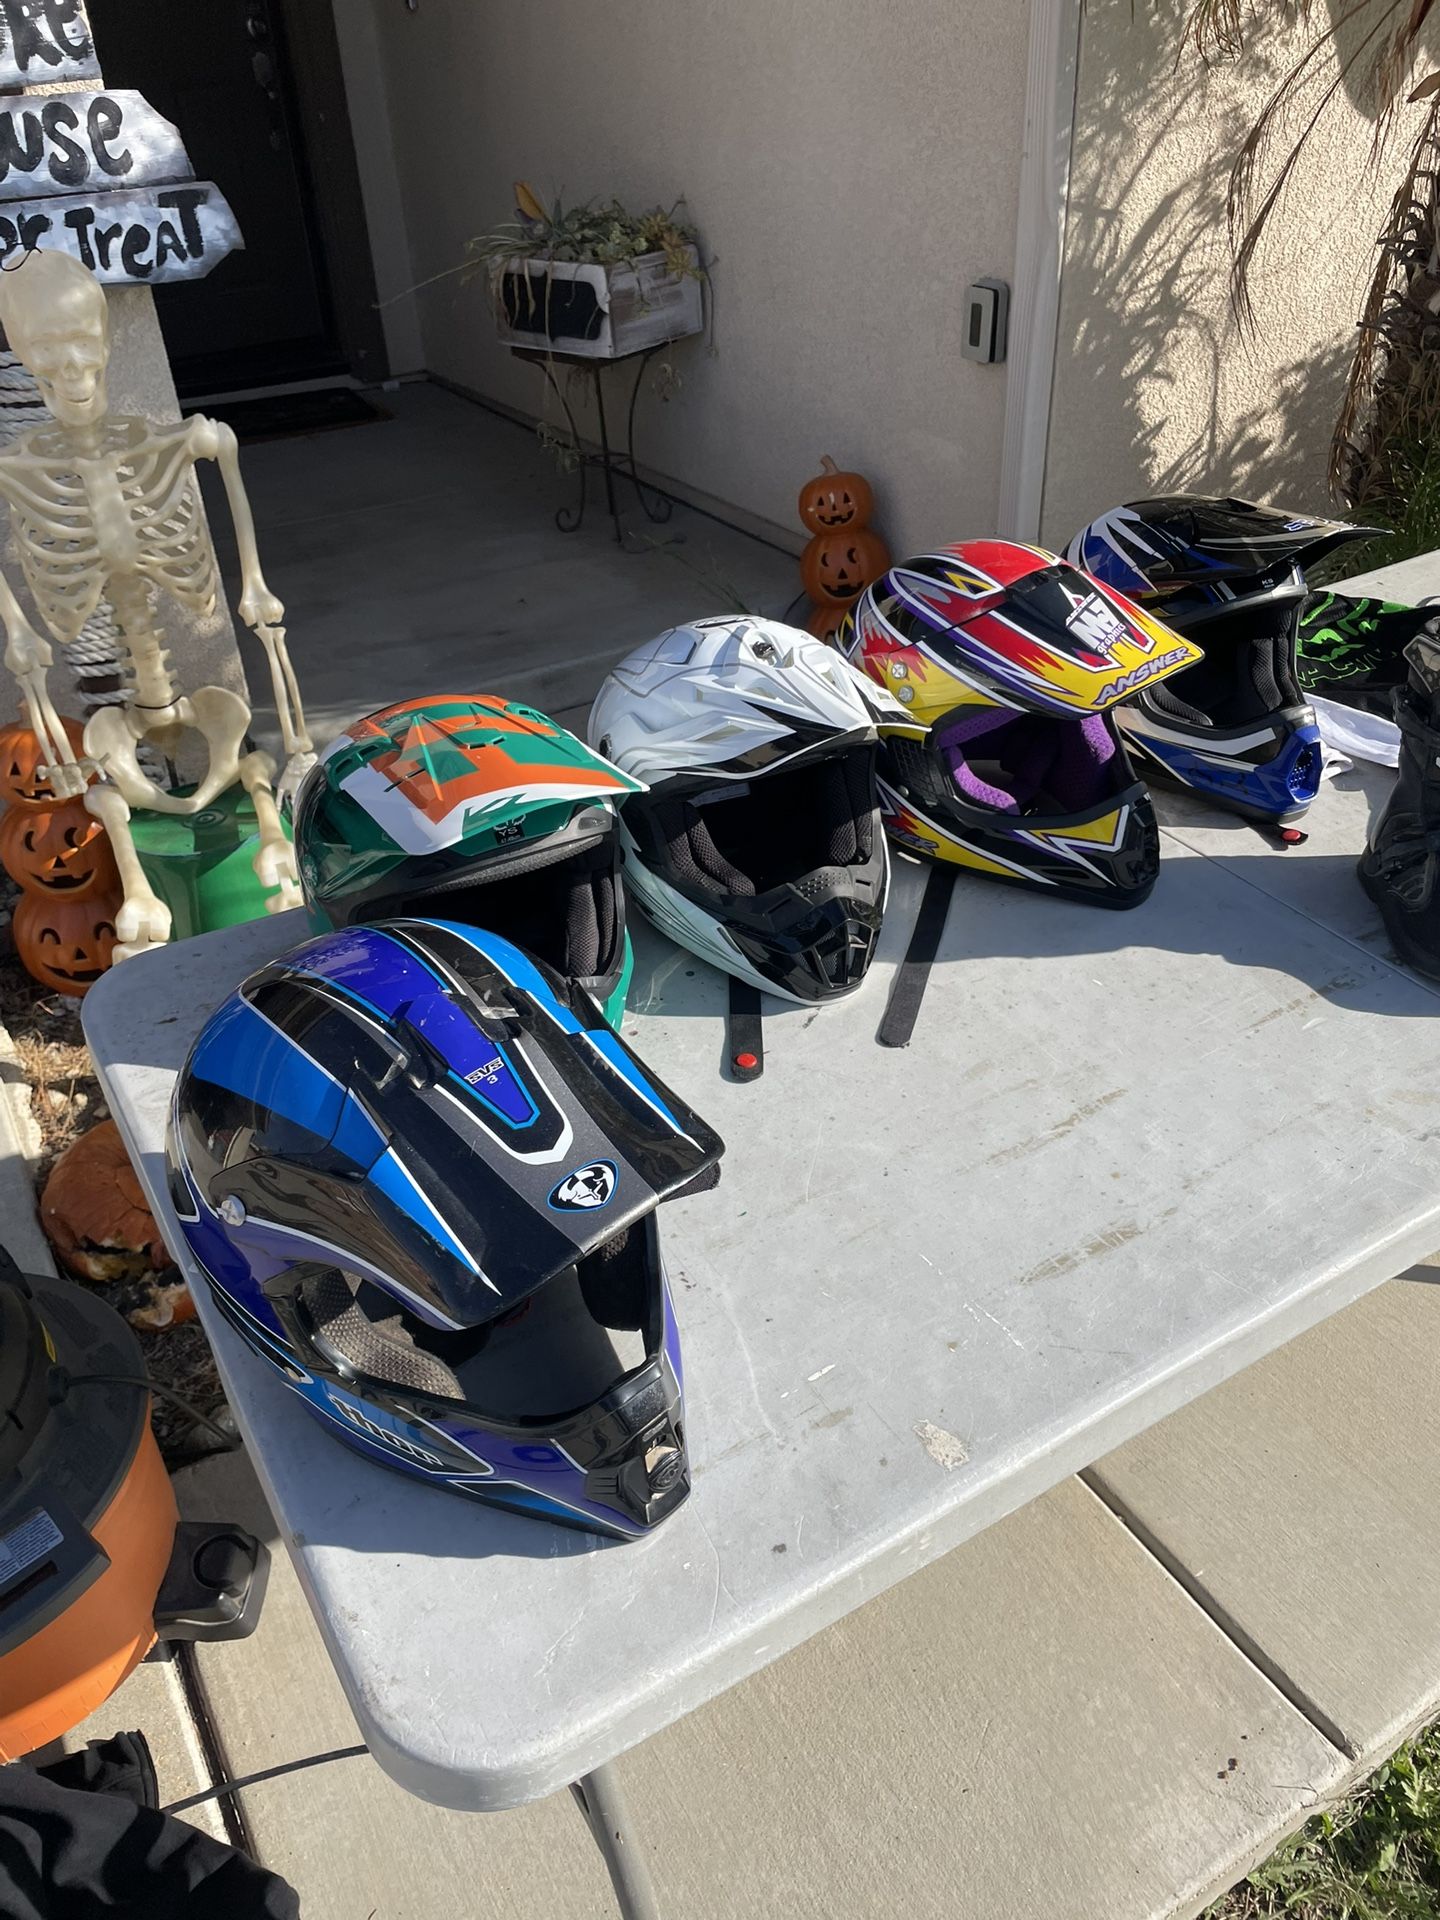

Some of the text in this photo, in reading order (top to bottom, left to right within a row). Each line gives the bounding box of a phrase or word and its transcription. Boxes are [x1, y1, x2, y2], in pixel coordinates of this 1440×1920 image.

[0, 97, 133, 186] use
[1092, 646, 1195, 705] ANSWER
[487, 1074, 498, 1084] 3
